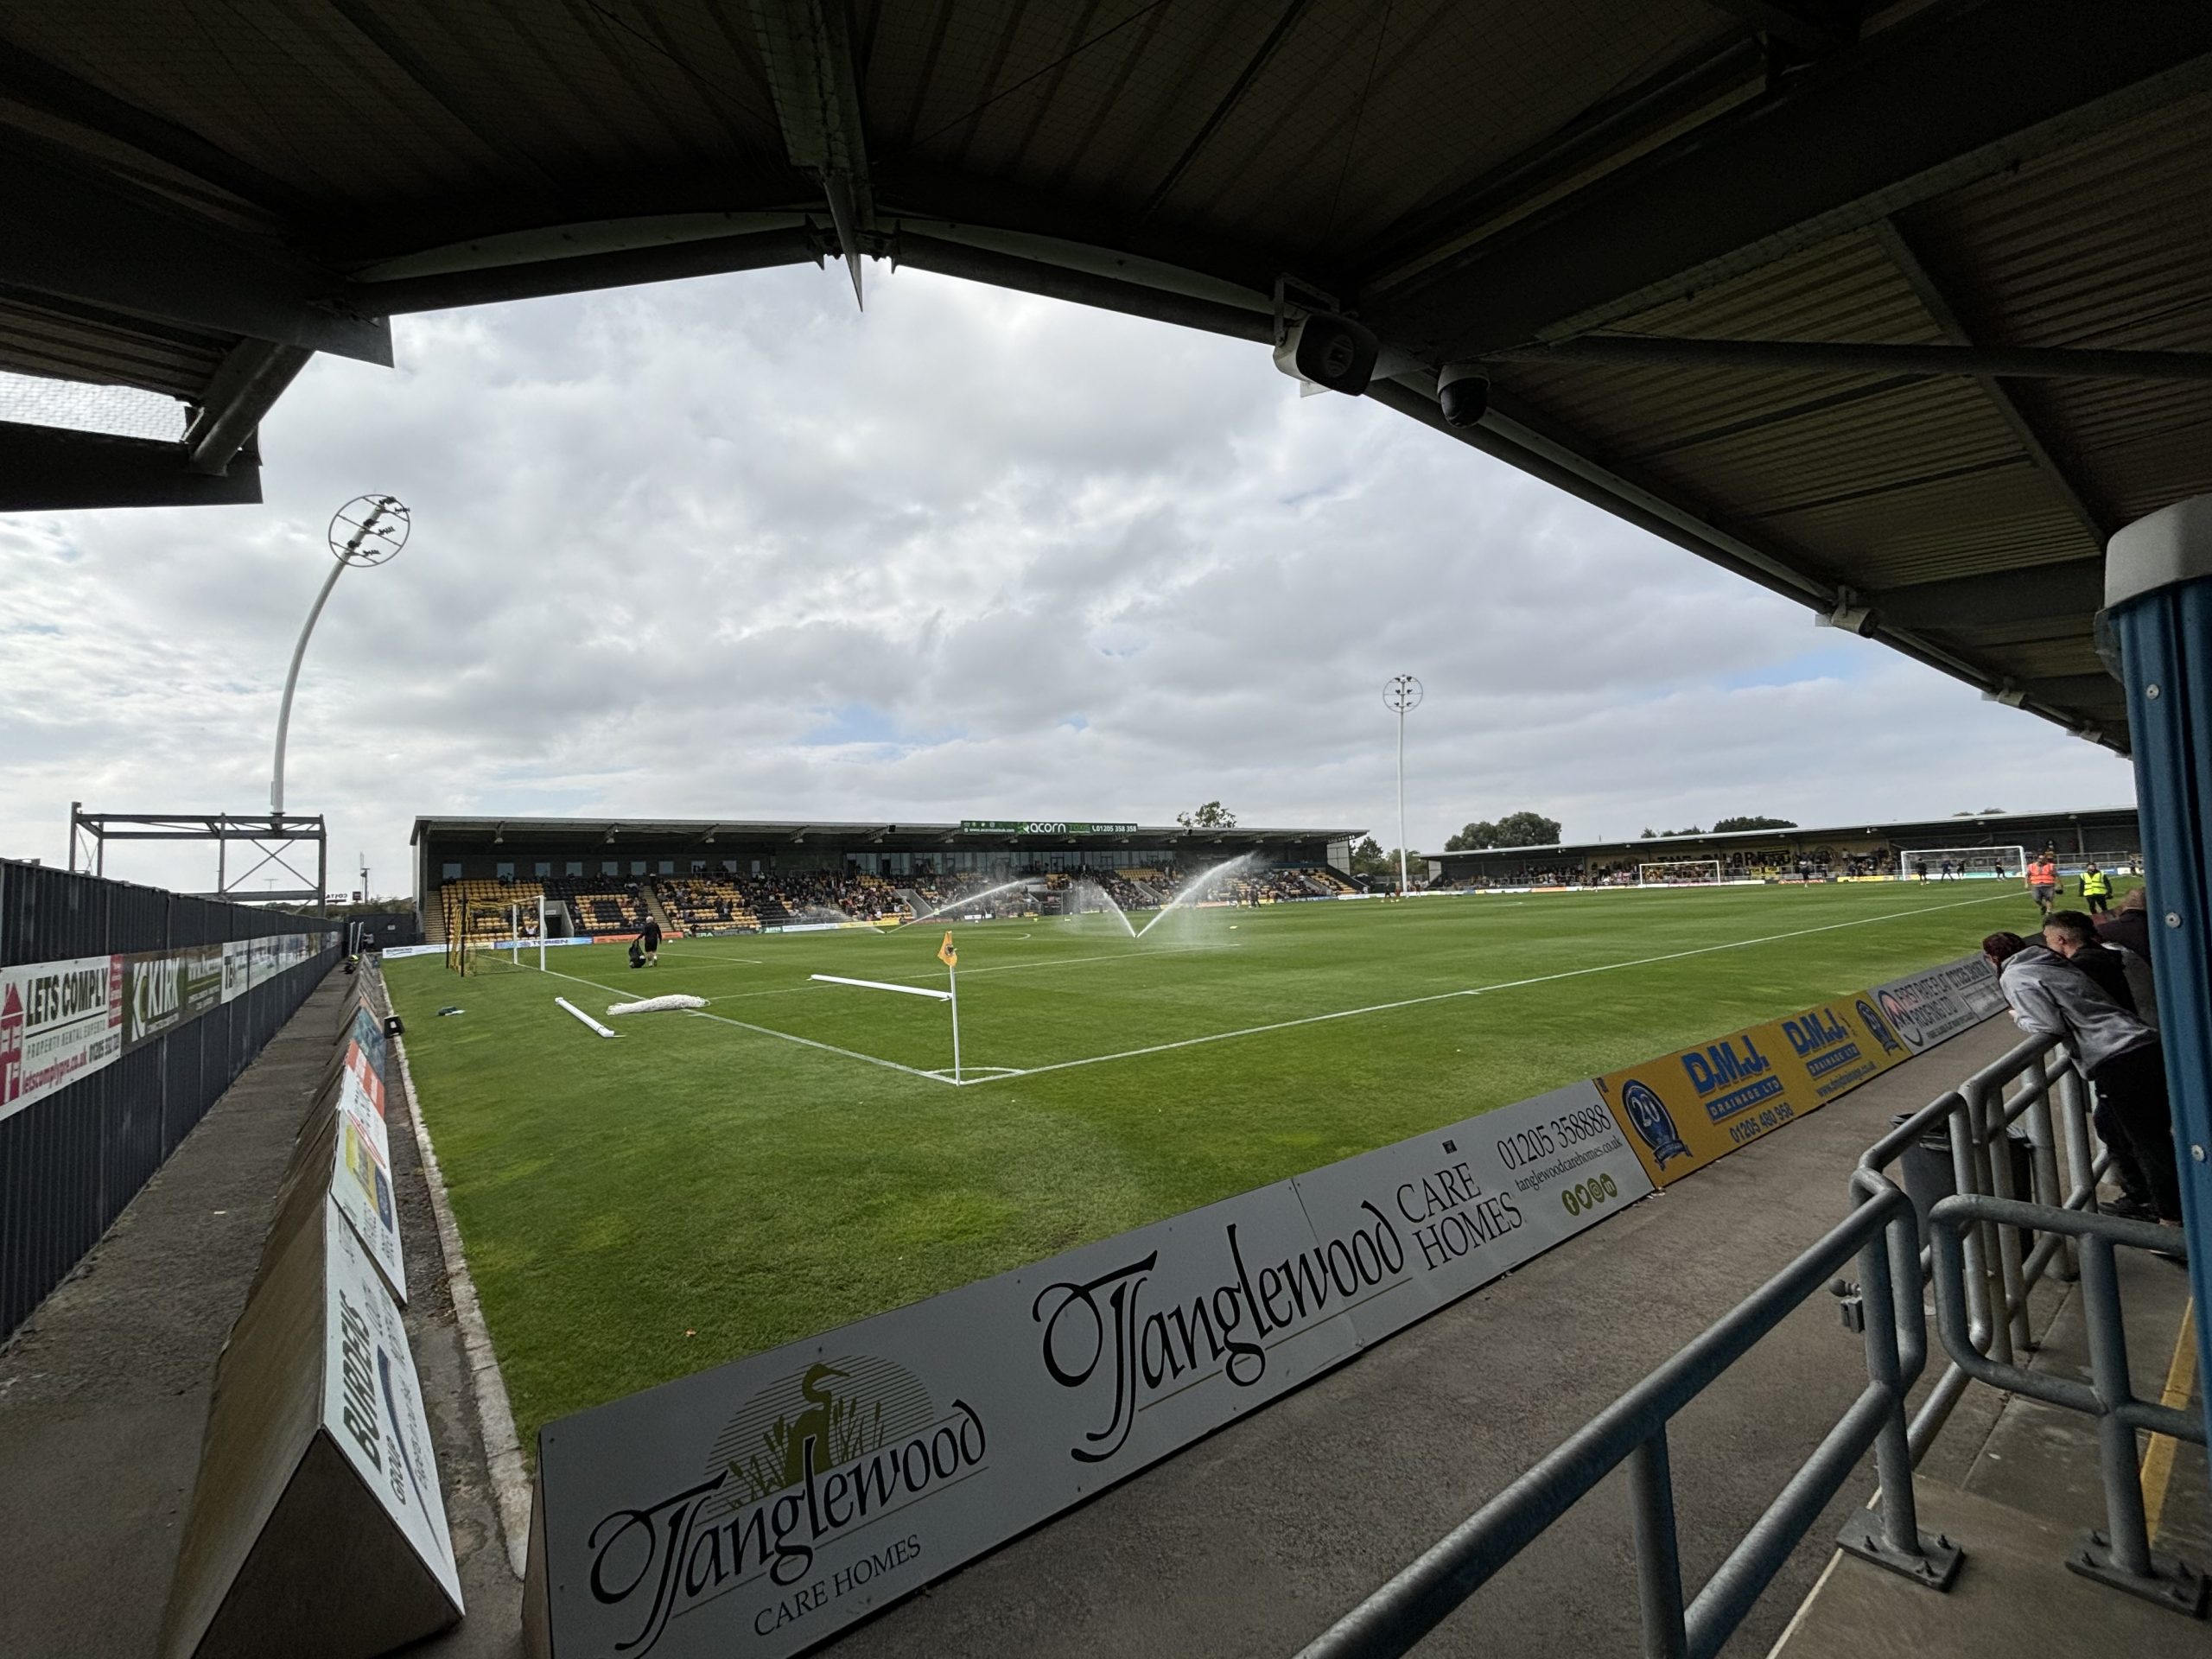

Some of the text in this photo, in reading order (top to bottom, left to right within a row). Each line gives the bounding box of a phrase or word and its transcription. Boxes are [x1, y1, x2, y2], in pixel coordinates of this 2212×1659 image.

[1030, 823, 1066, 833] acorn
[26, 975, 59, 1027] LETS
[62, 967, 109, 1017] COMPLY
[148, 957, 180, 1018] KIRK
[1894, 984, 1923, 1007] FIRST
[1912, 978, 1938, 1000] RATE
[1910, 1000, 1947, 1028] ROOFING
[1936, 996, 1959, 1016] LTD
[1631, 1093, 1661, 1128] 20
[1710, 1079, 1781, 1117] DRAINAGE LTD
[1730, 1102, 1795, 1144] 01205 480 958
[1497, 1104, 1612, 1170] 01205 358888
[1515, 1135, 1624, 1192] tanglewoodcarehomes.co.uk
[1396, 1161, 1482, 1224] CARE
[1412, 1192, 1523, 1271] HOMES
[1032, 1199, 1404, 1463] Tanglewood
[340, 1288, 382, 1475] BURDENS
[385, 1434, 407, 1506] GROUP
[588, 1399, 987, 1659] Tanglewood
[754, 1534, 922, 1637] CARE HOMES
